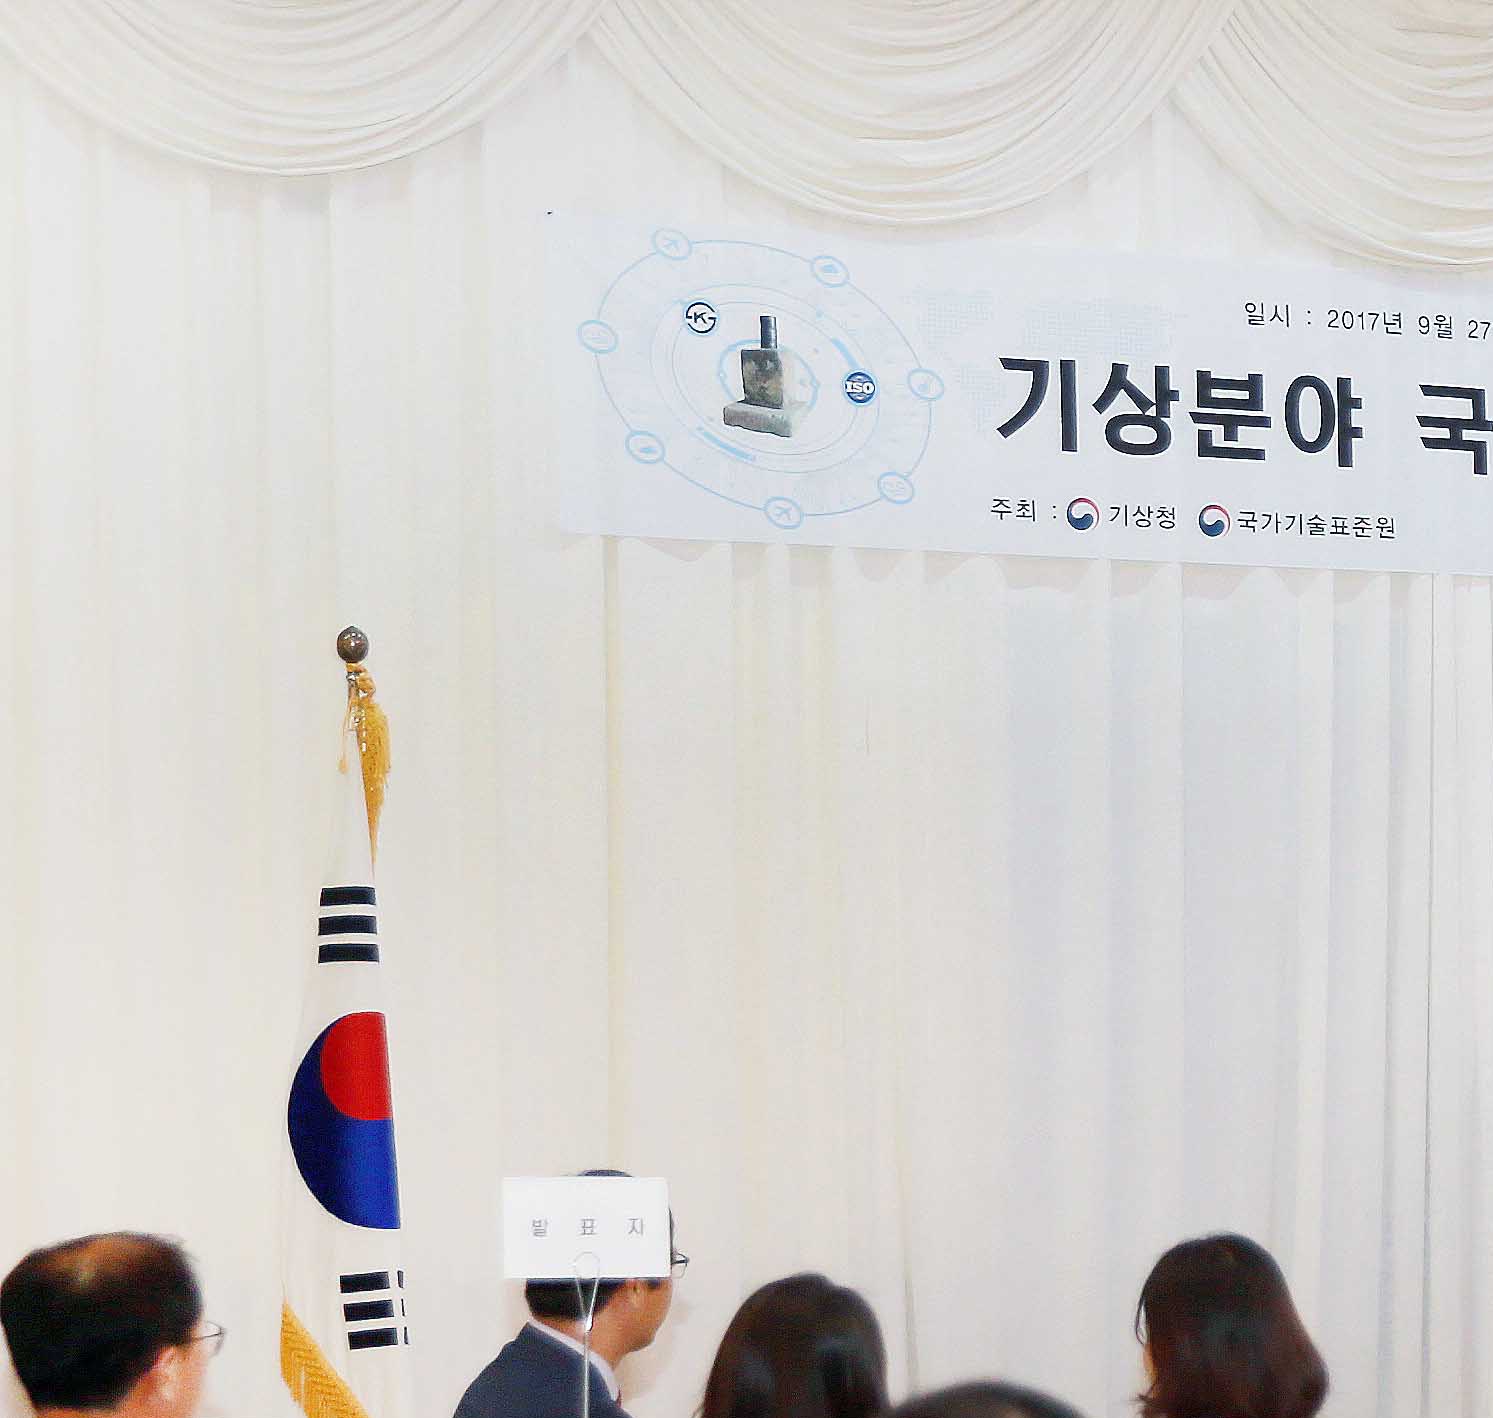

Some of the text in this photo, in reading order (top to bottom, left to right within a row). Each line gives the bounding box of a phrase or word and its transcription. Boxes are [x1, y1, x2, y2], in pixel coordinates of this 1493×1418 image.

[1244, 302, 1290, 329] 일시
[1327, 309, 1403, 336] 2017년
[1418, 314, 1453, 340] 9월
[844, 382, 876, 395] ISO
[995, 357, 1364, 468] 기상분야
[990, 498, 1036, 523] 주최
[1108, 504, 1176, 530] 기상청
[1236, 511, 1396, 540] 국가기술표준원
